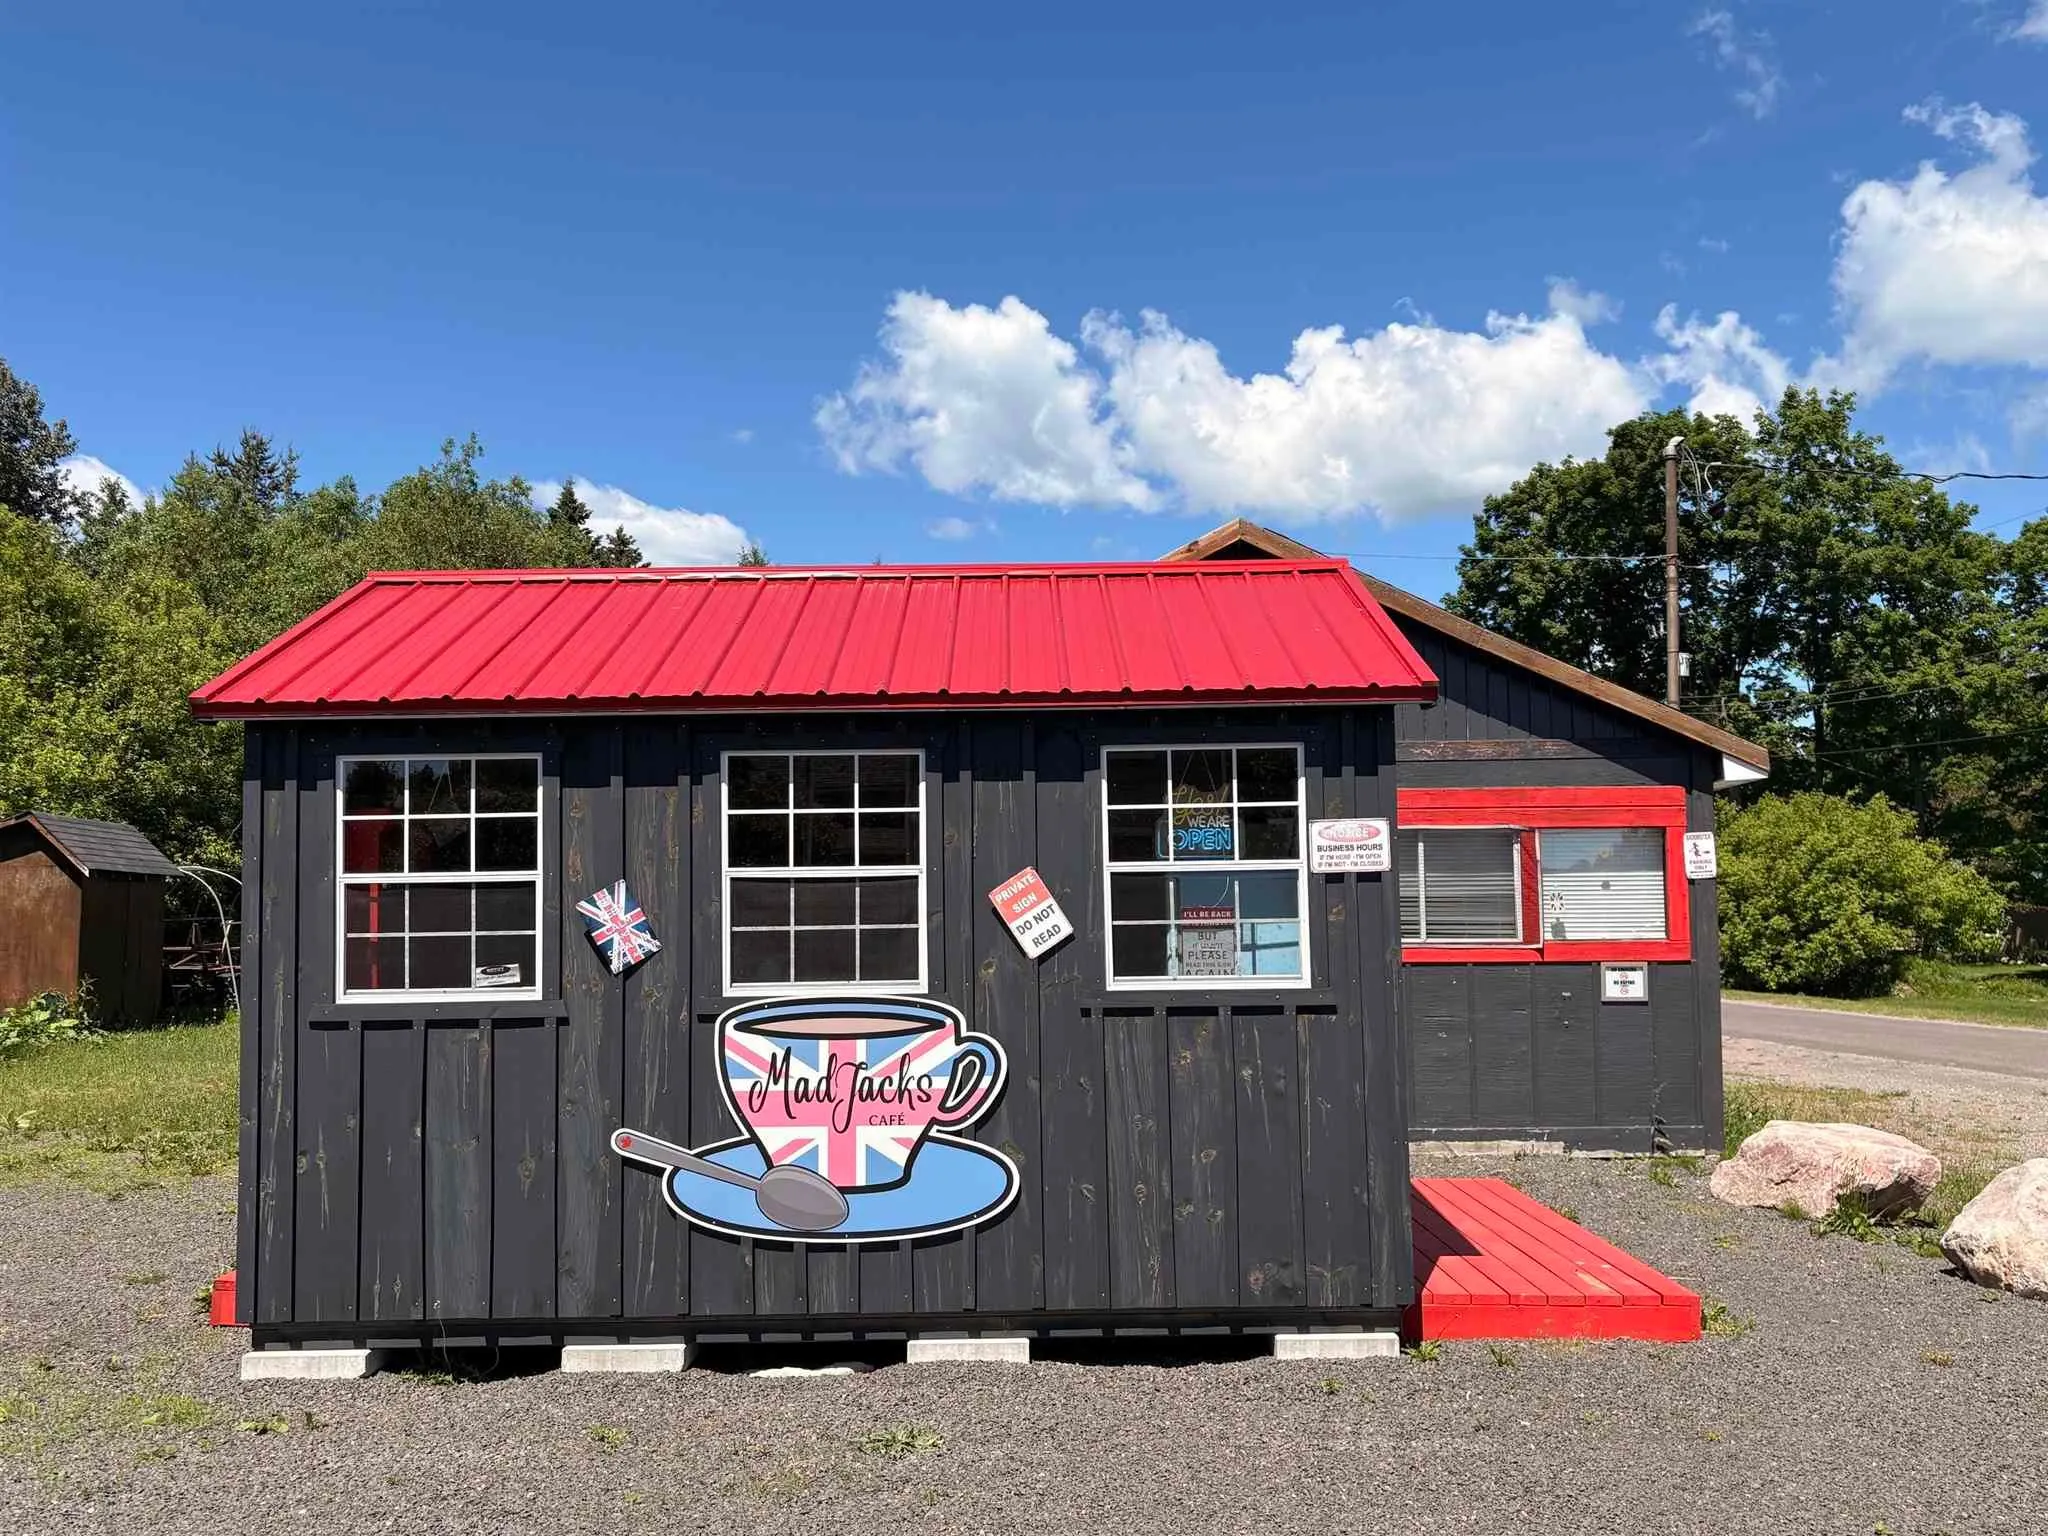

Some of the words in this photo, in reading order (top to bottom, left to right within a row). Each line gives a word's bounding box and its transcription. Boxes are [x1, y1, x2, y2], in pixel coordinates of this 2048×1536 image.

[1188, 816, 1207, 828] WE
[1207, 815, 1230, 828] ARE
[1170, 827, 1232, 850] OPEN
[1317, 844, 1355, 852] BUSINESS
[1356, 843, 1383, 852] HOURS
[994, 874, 1036, 905] PRIVATE
[1011, 891, 1038, 913] SIGN
[1016, 920, 1033, 935] DO
[1032, 904, 1056, 925] NOT
[1032, 924, 1062, 948] READ
[1198, 931, 1217, 941] BUT
[1188, 951, 1228, 960] PLEASE
[748, 1046, 838, 1120] Mad
[832, 1052, 933, 1134] Jacks
[868, 1112, 906, 1126] CAFÉ
